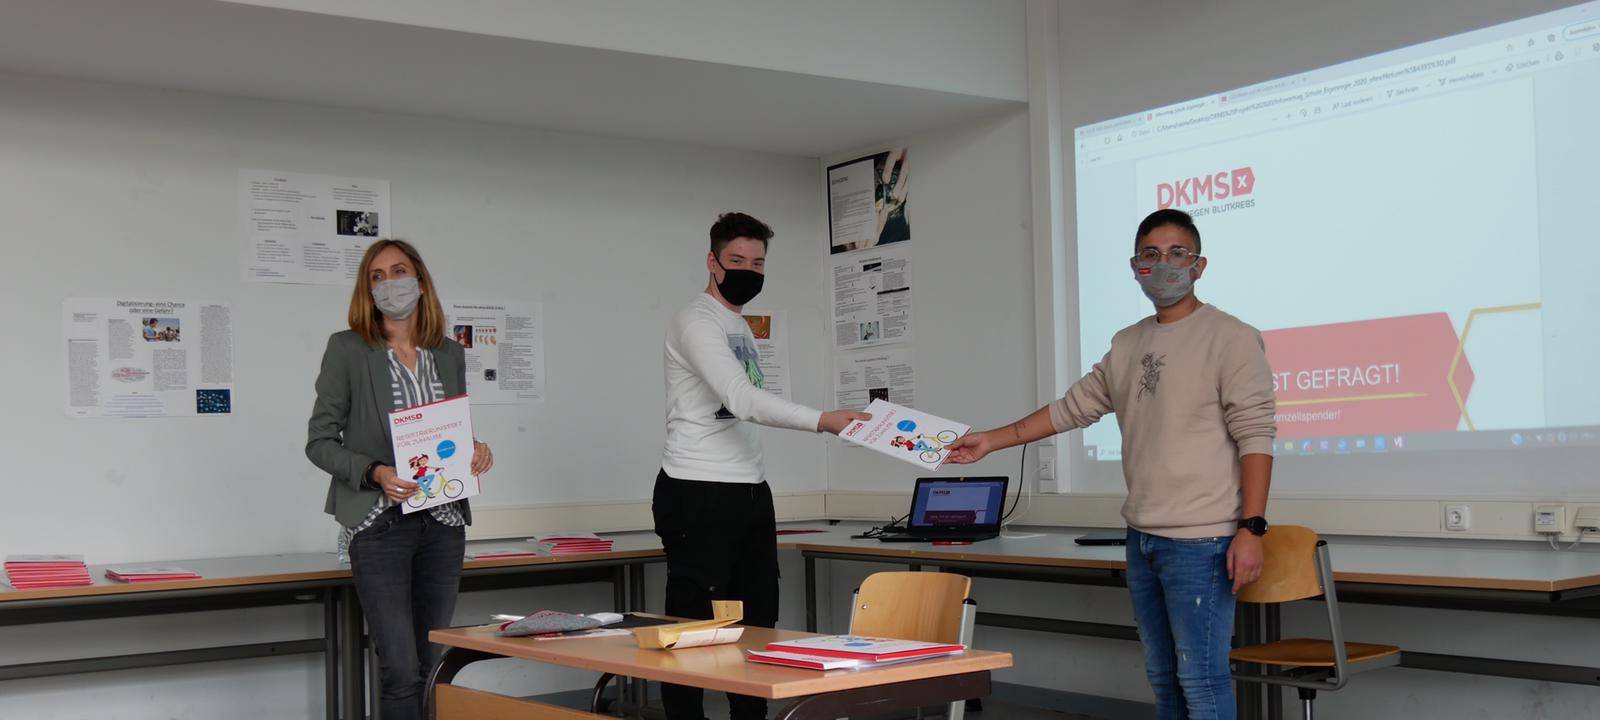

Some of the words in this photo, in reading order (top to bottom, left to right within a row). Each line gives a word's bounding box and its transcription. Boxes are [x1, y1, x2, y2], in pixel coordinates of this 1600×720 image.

[1157, 172, 1230, 210] DKMS
[1212, 199, 1256, 214] BLUTKREBS
[1272, 371, 1291, 392] ST
[1296, 363, 1400, 391] GEFRAGT!
